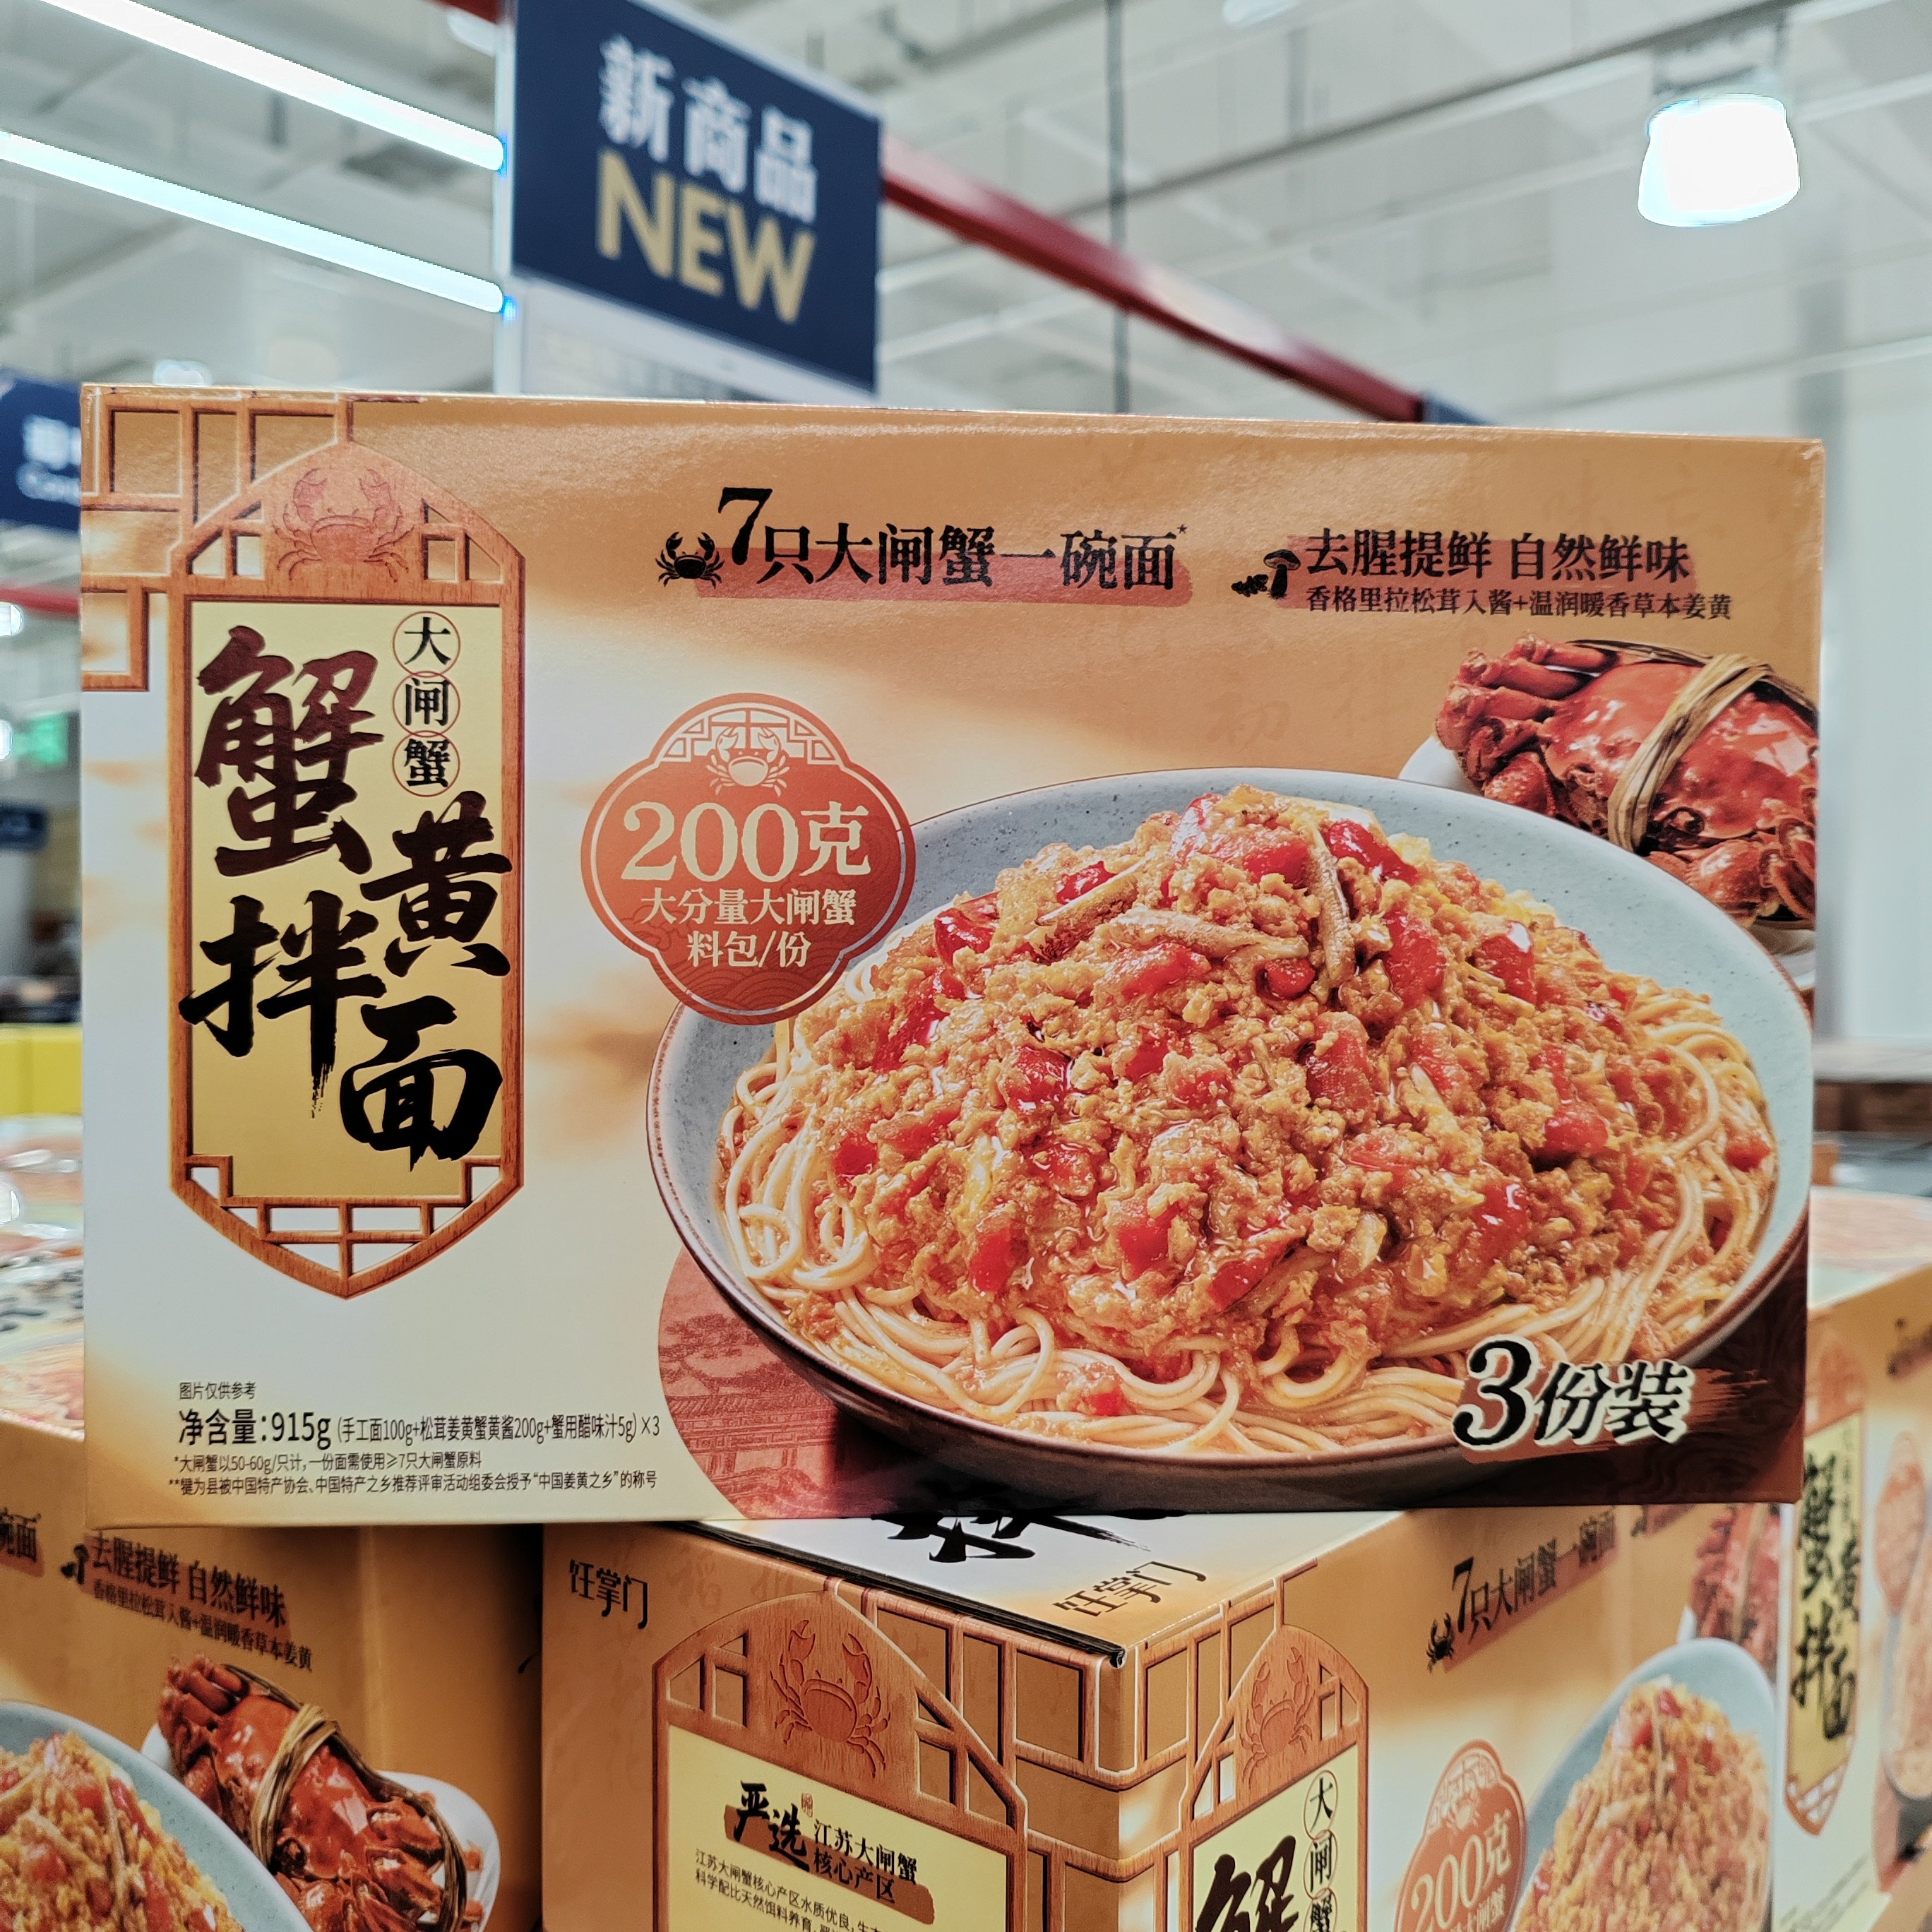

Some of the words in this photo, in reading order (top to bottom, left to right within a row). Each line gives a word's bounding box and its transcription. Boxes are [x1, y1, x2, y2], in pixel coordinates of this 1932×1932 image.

[599, 34, 818, 225] 新商品
[596, 147, 816, 324] NEW
[1306, 527, 1493, 580] 去腥提鲜
[1510, 532, 1692, 584] 自然鲜味
[1306, 585, 1732, 621] 香格里拉松茸入酱+温润暖香草本姜黄
[403, 616, 451, 788] 大闸蟹
[621, 801, 871, 882] 200克
[640, 887, 857, 925] 大分量大闸蟹
[686, 930, 811, 967] 料包/份
[179, 1381, 256, 1400] 图片仅供参考
[1451, 1337, 1692, 1448] 3份装
[189, 1559, 286, 1628] 自然鲜味
[734, 1779, 811, 1873] 严选
[813, 1818, 917, 1885] 江苏大闸蟹
[813, 1847, 895, 1904] 核心产区
[1411, 1808, 1512, 1932] 200克
